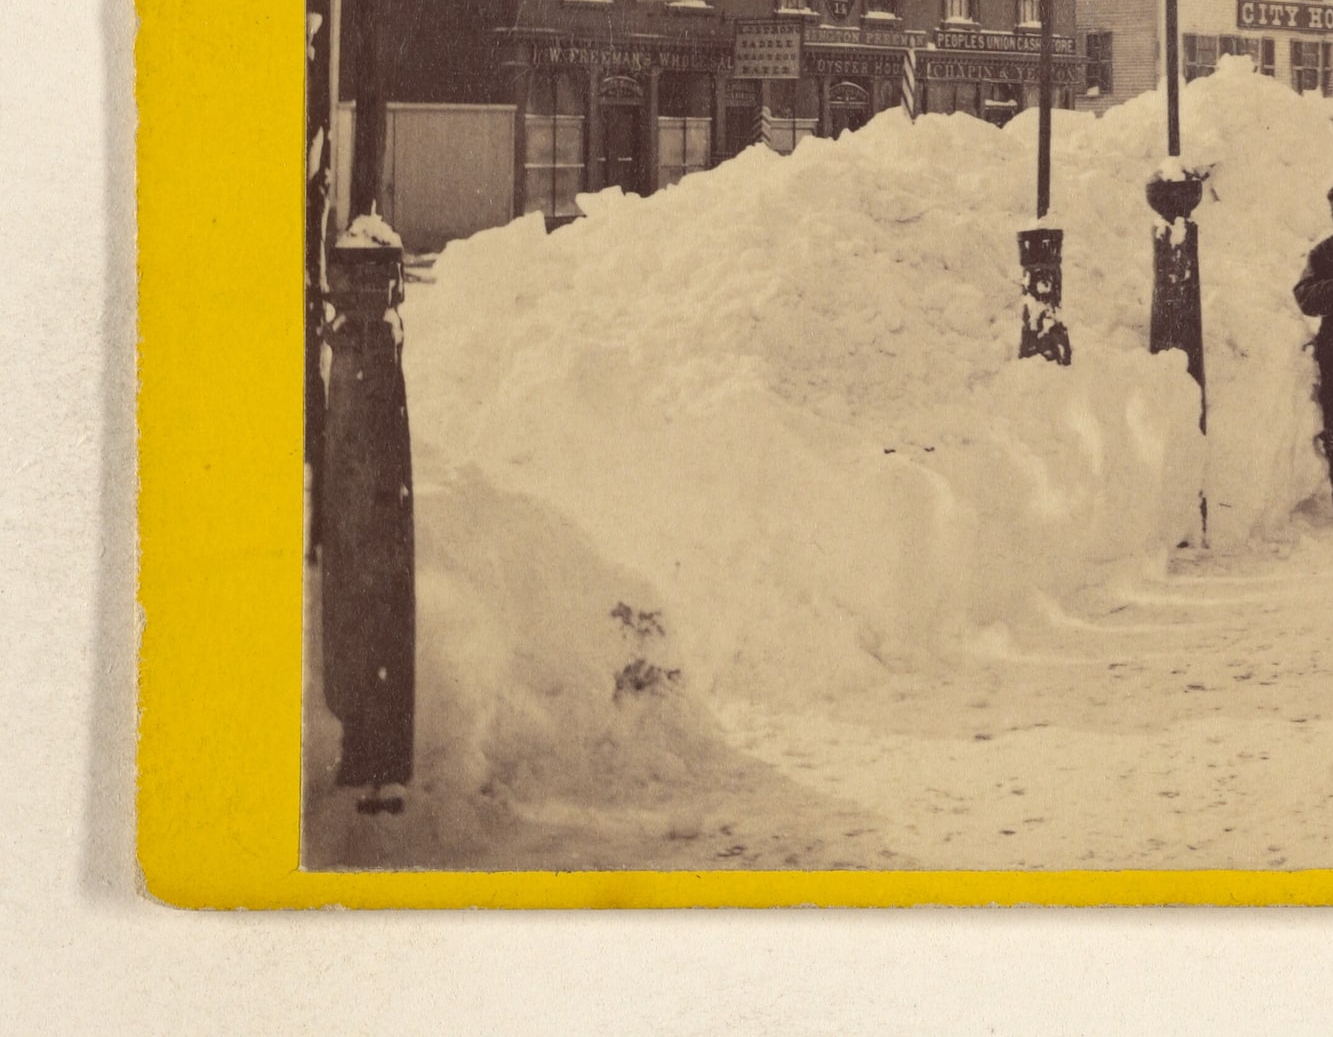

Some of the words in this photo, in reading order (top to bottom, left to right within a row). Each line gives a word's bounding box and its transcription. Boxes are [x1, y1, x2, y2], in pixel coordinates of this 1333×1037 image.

[1241, 2, 1300, 27] CITY
[986, 35, 1015, 51] UNION
[1016, 36, 1042, 53] CASH
[817, 59, 868, 74] OYSTER
[933, 64, 994, 79] CHAPIN
